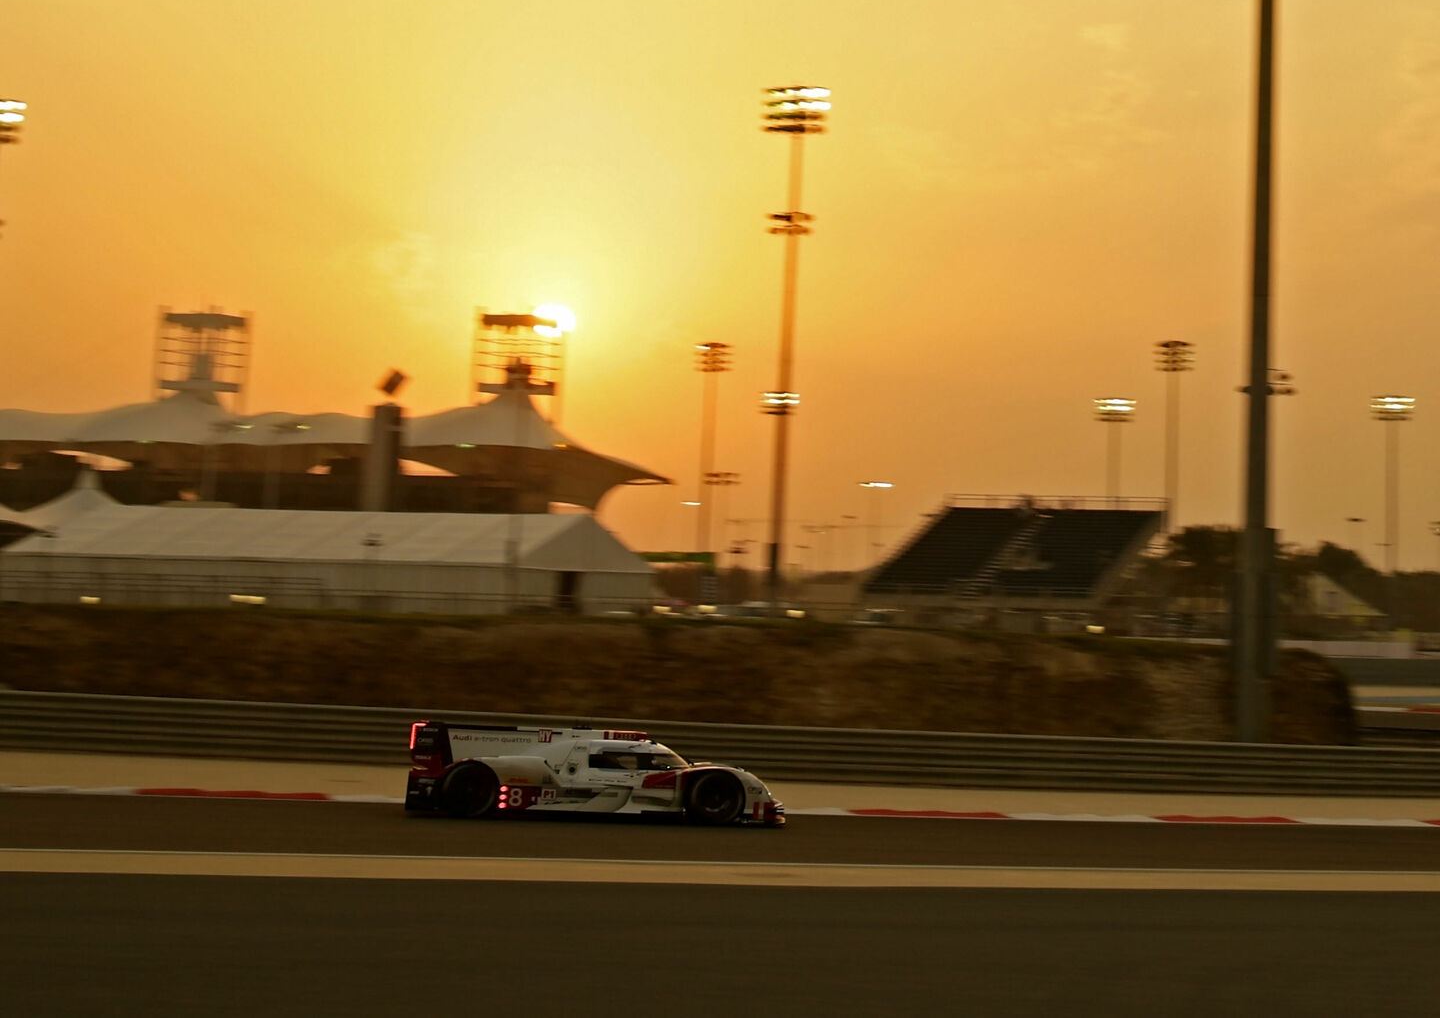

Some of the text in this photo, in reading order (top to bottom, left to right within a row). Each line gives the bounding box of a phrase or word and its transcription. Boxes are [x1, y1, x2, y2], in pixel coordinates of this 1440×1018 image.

[539, 730, 552, 742] HY
[509, 788, 522, 806] 8
[543, 790, 555, 799] P1
